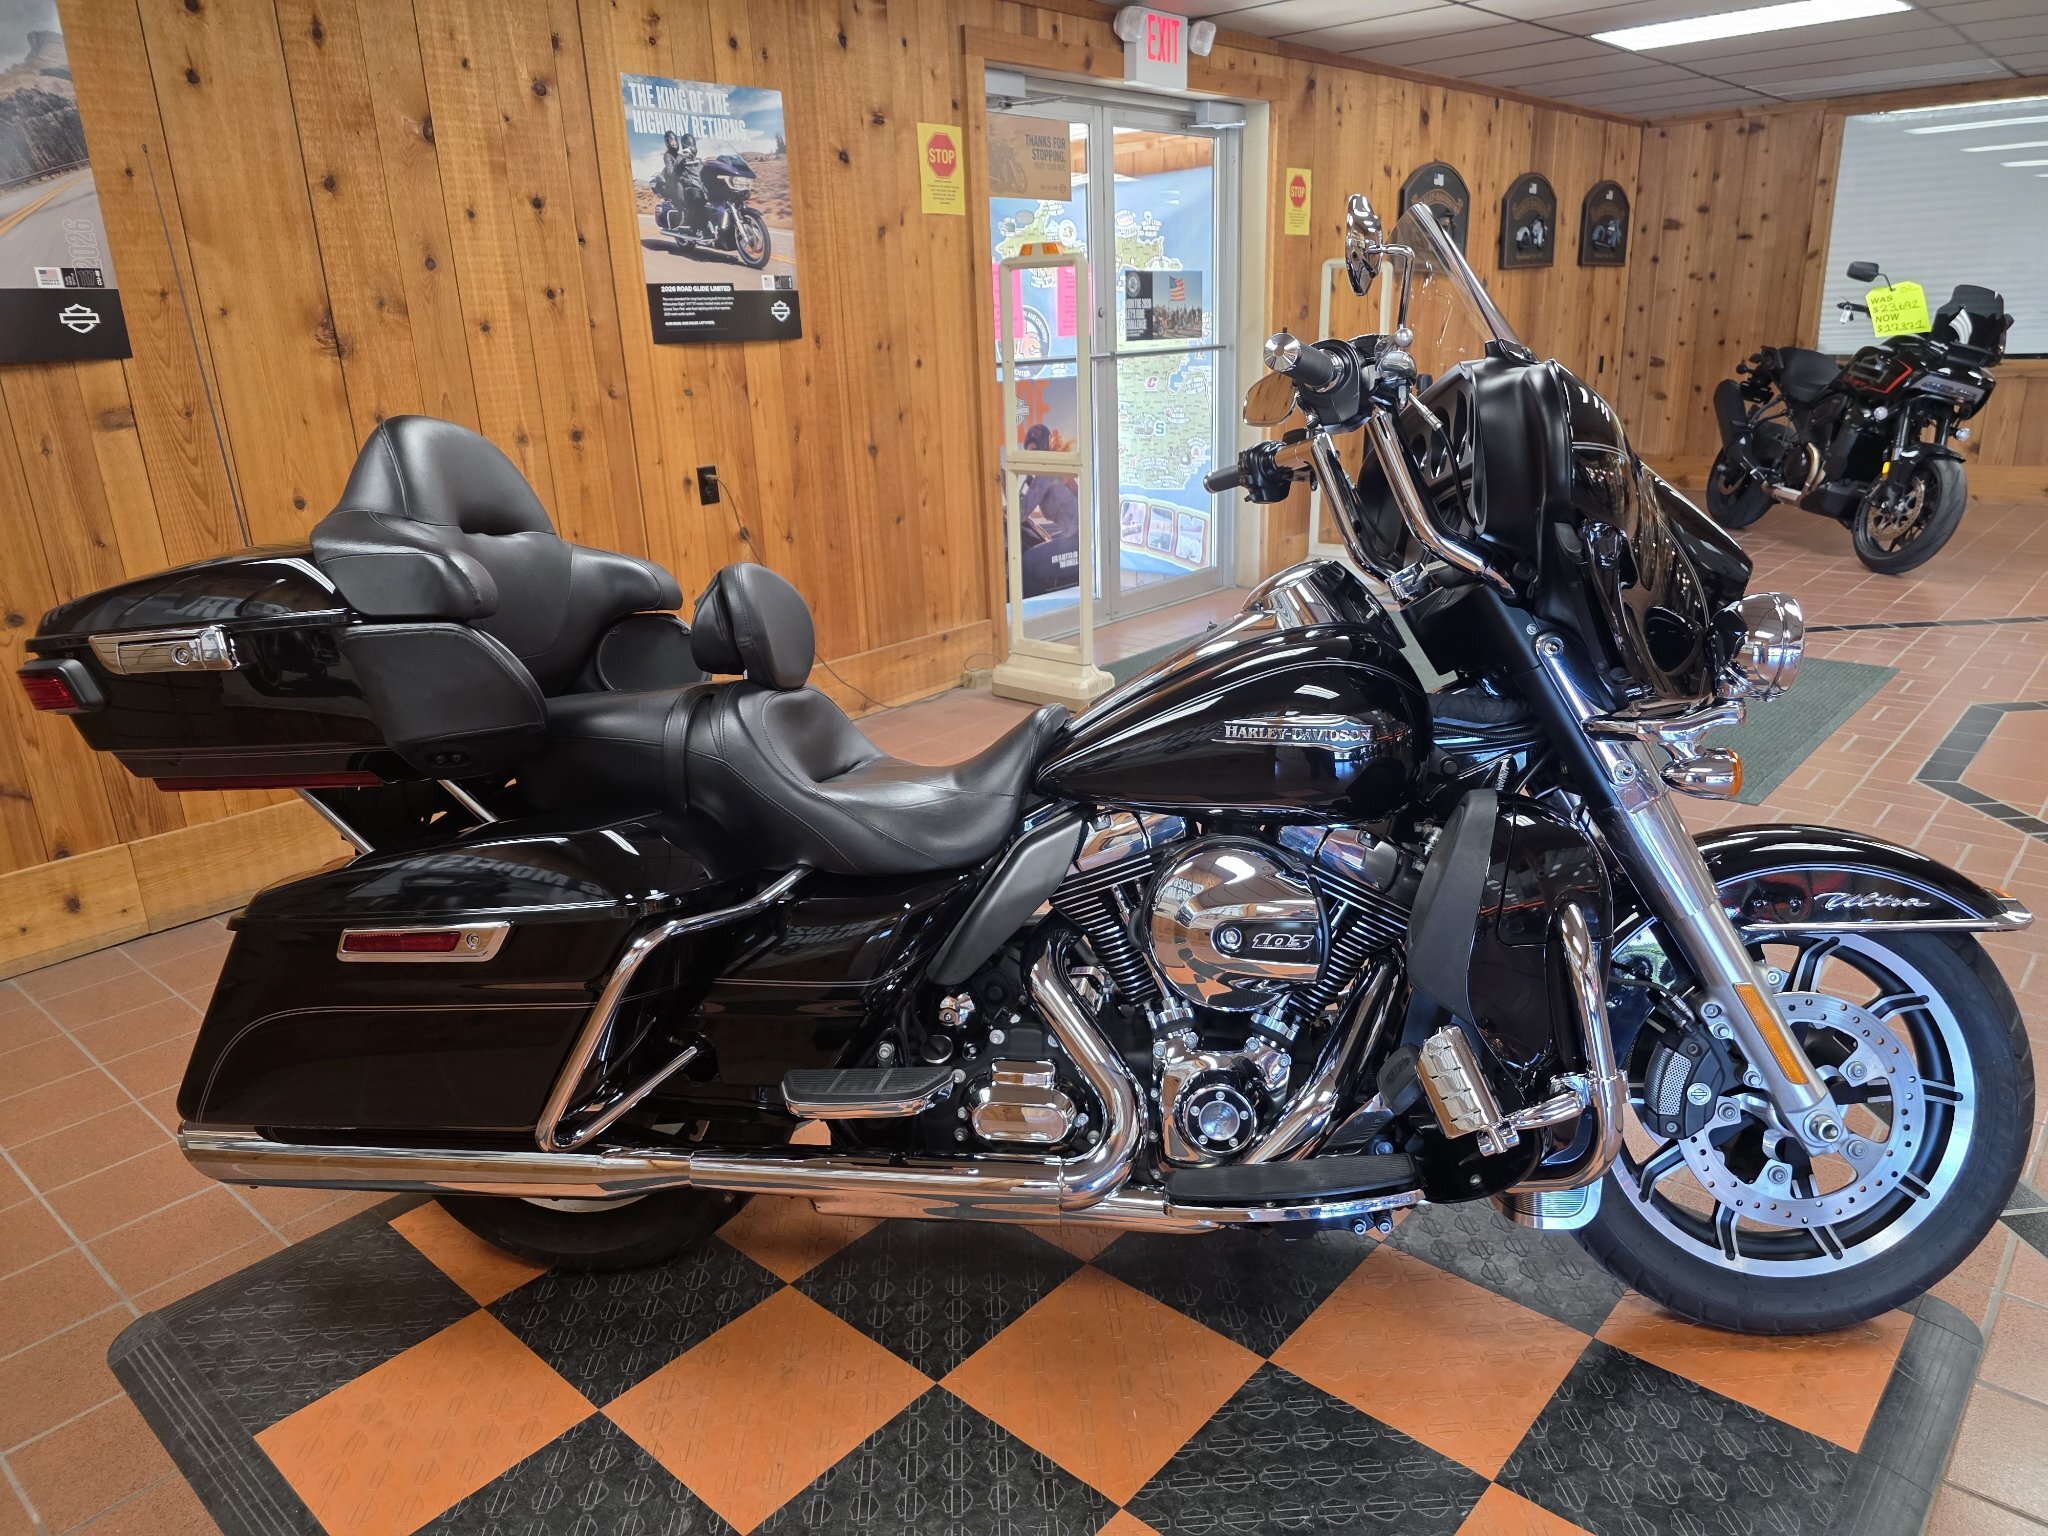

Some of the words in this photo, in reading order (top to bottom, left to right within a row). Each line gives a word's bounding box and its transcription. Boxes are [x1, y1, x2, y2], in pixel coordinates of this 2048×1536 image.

[1146, 13, 1181, 65] EXIT
[627, 82, 655, 109] THE
[656, 85, 688, 112] KING
[690, 90, 706, 113] OF
[706, 91, 731, 116] THE
[631, 109, 690, 137] HIGHWAY
[691, 115, 751, 142] RETURNS.
[1025, 133, 1052, 148] THANKS
[1053, 136, 1066, 150] FOR
[928, 148, 956, 165] STOP
[1032, 148, 1067, 163] STOPPING.
[1290, 185, 1306, 198] STOP
[63, 219, 102, 268] 2026
[661, 285, 677, 293] 2026
[1870, 295, 1893, 304] WAS
[1875, 313, 1900, 322] NOW
[1224, 724, 1371, 742] HARLEY-DAVIDSON
[1813, 891, 1931, 911] Ultra
[1252, 933, 1315, 950] 103
